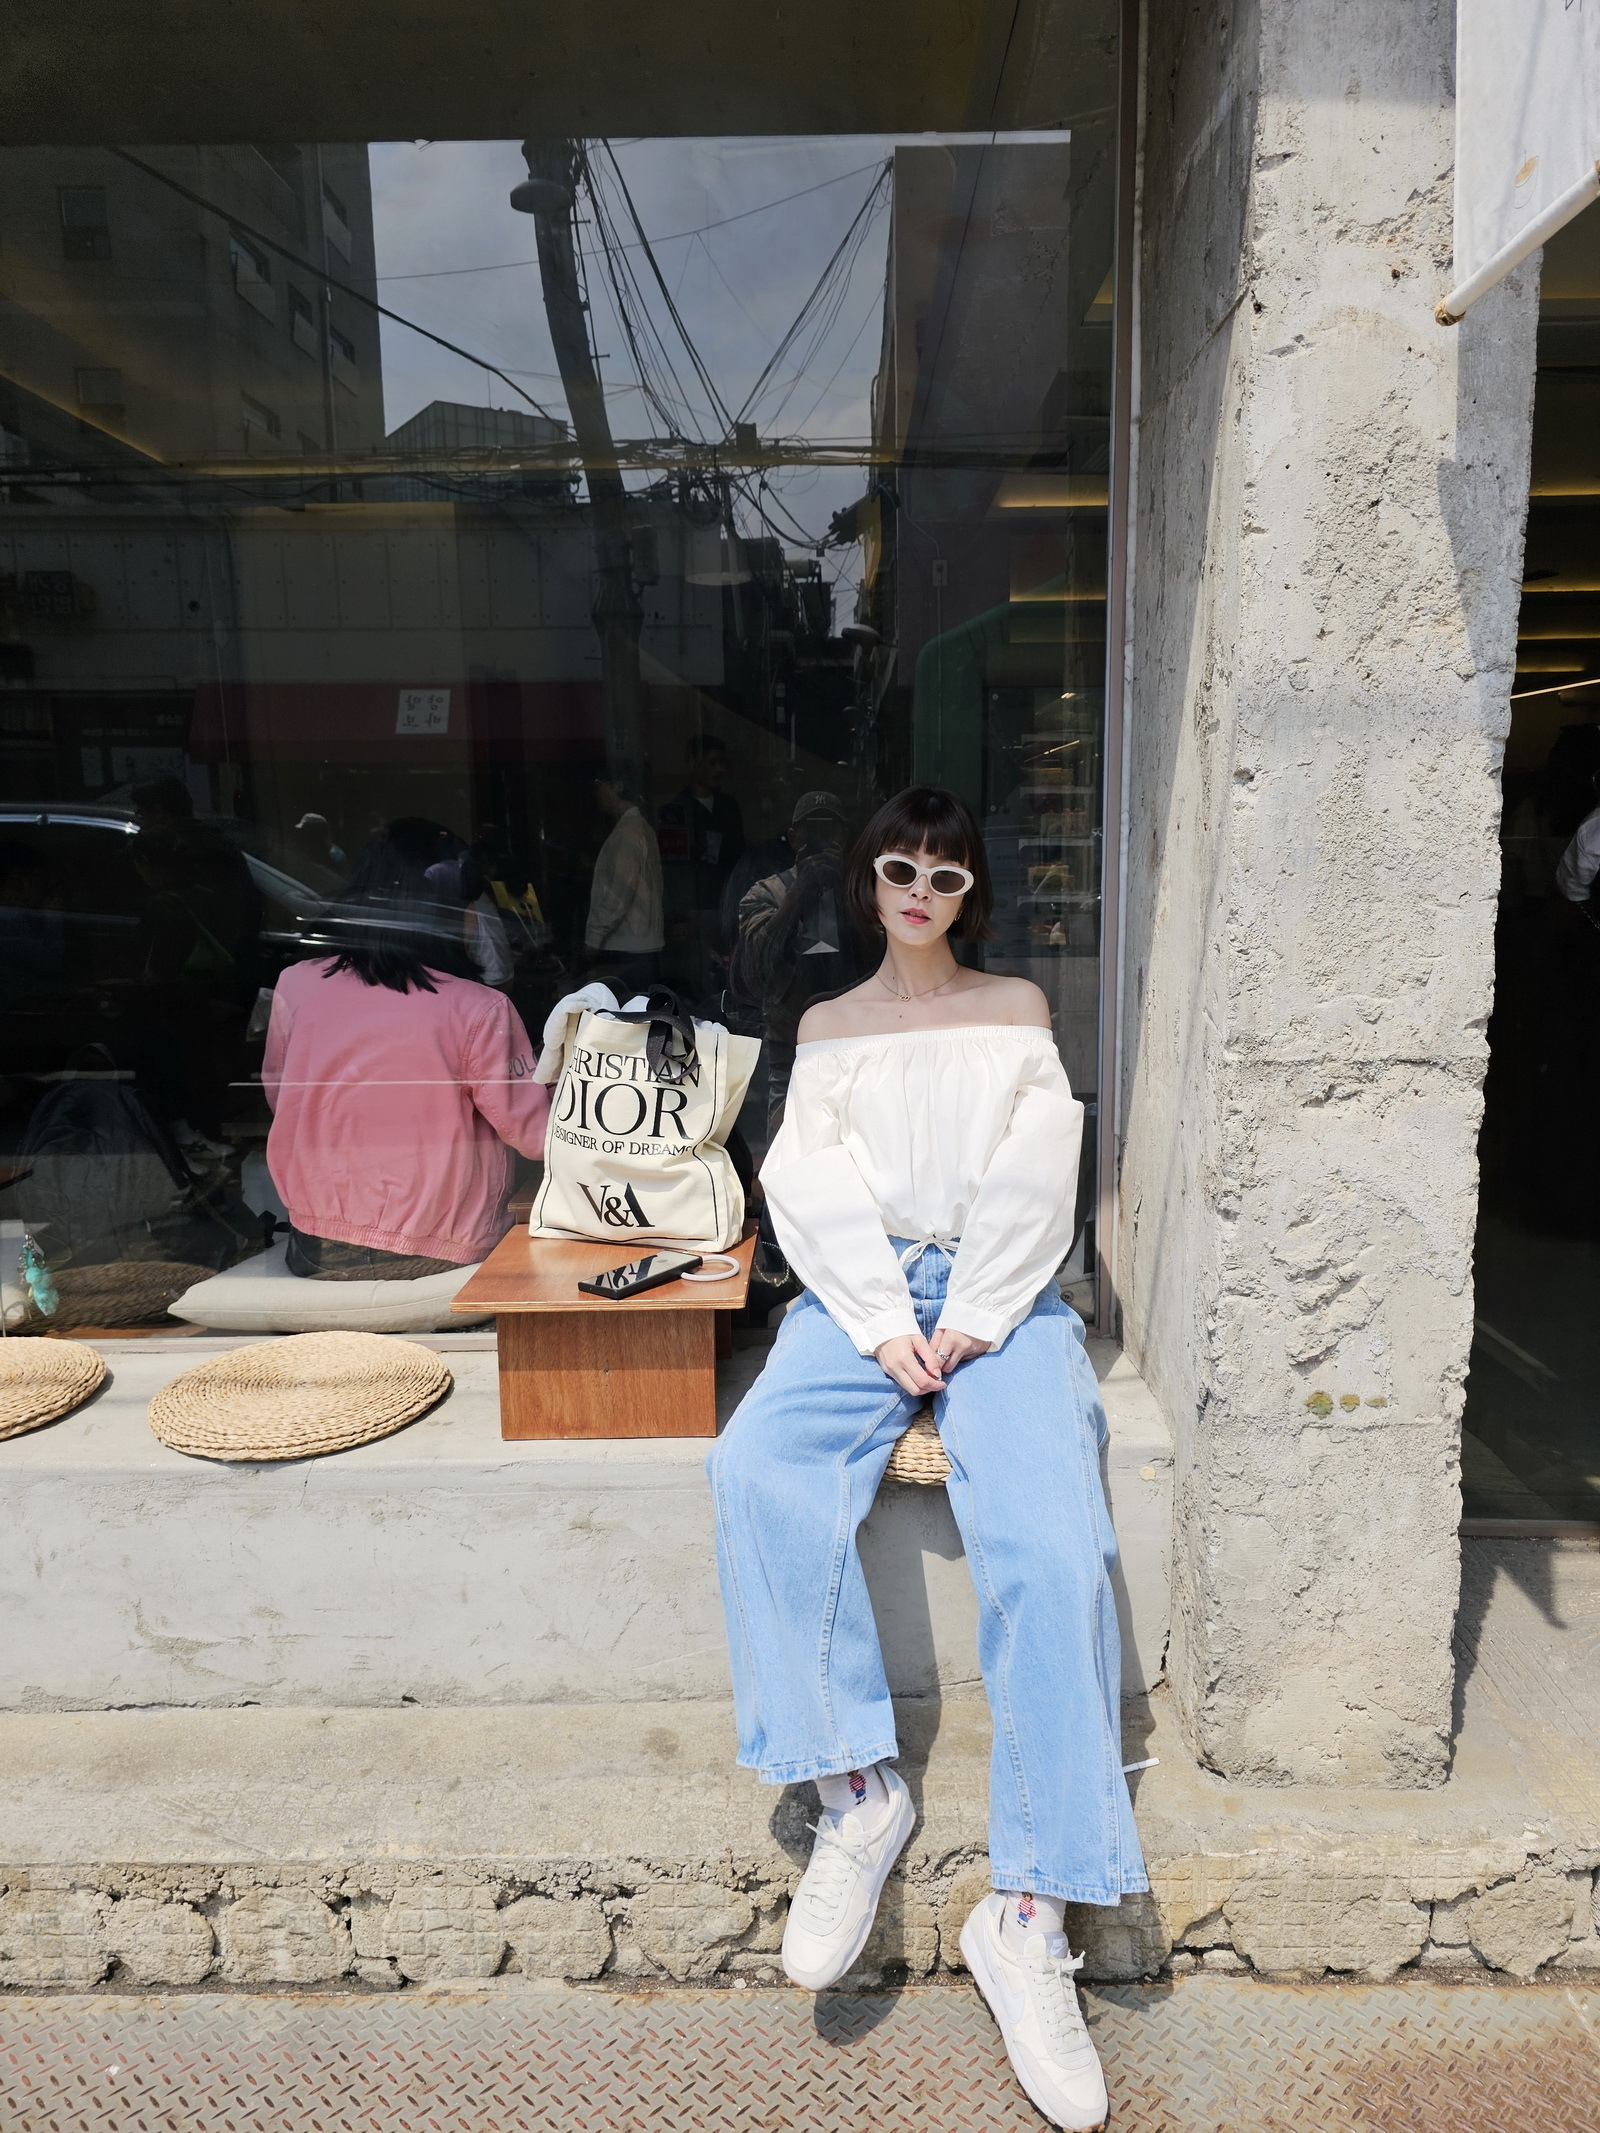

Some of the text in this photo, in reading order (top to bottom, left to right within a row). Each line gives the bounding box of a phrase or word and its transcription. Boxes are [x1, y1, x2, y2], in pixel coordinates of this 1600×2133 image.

[569, 1045, 702, 1088] HRISTIAN
[554, 1122, 599, 1152] ESIGNER
[602, 1140, 625, 1155] OF
[576, 1182, 656, 1228] V&A
